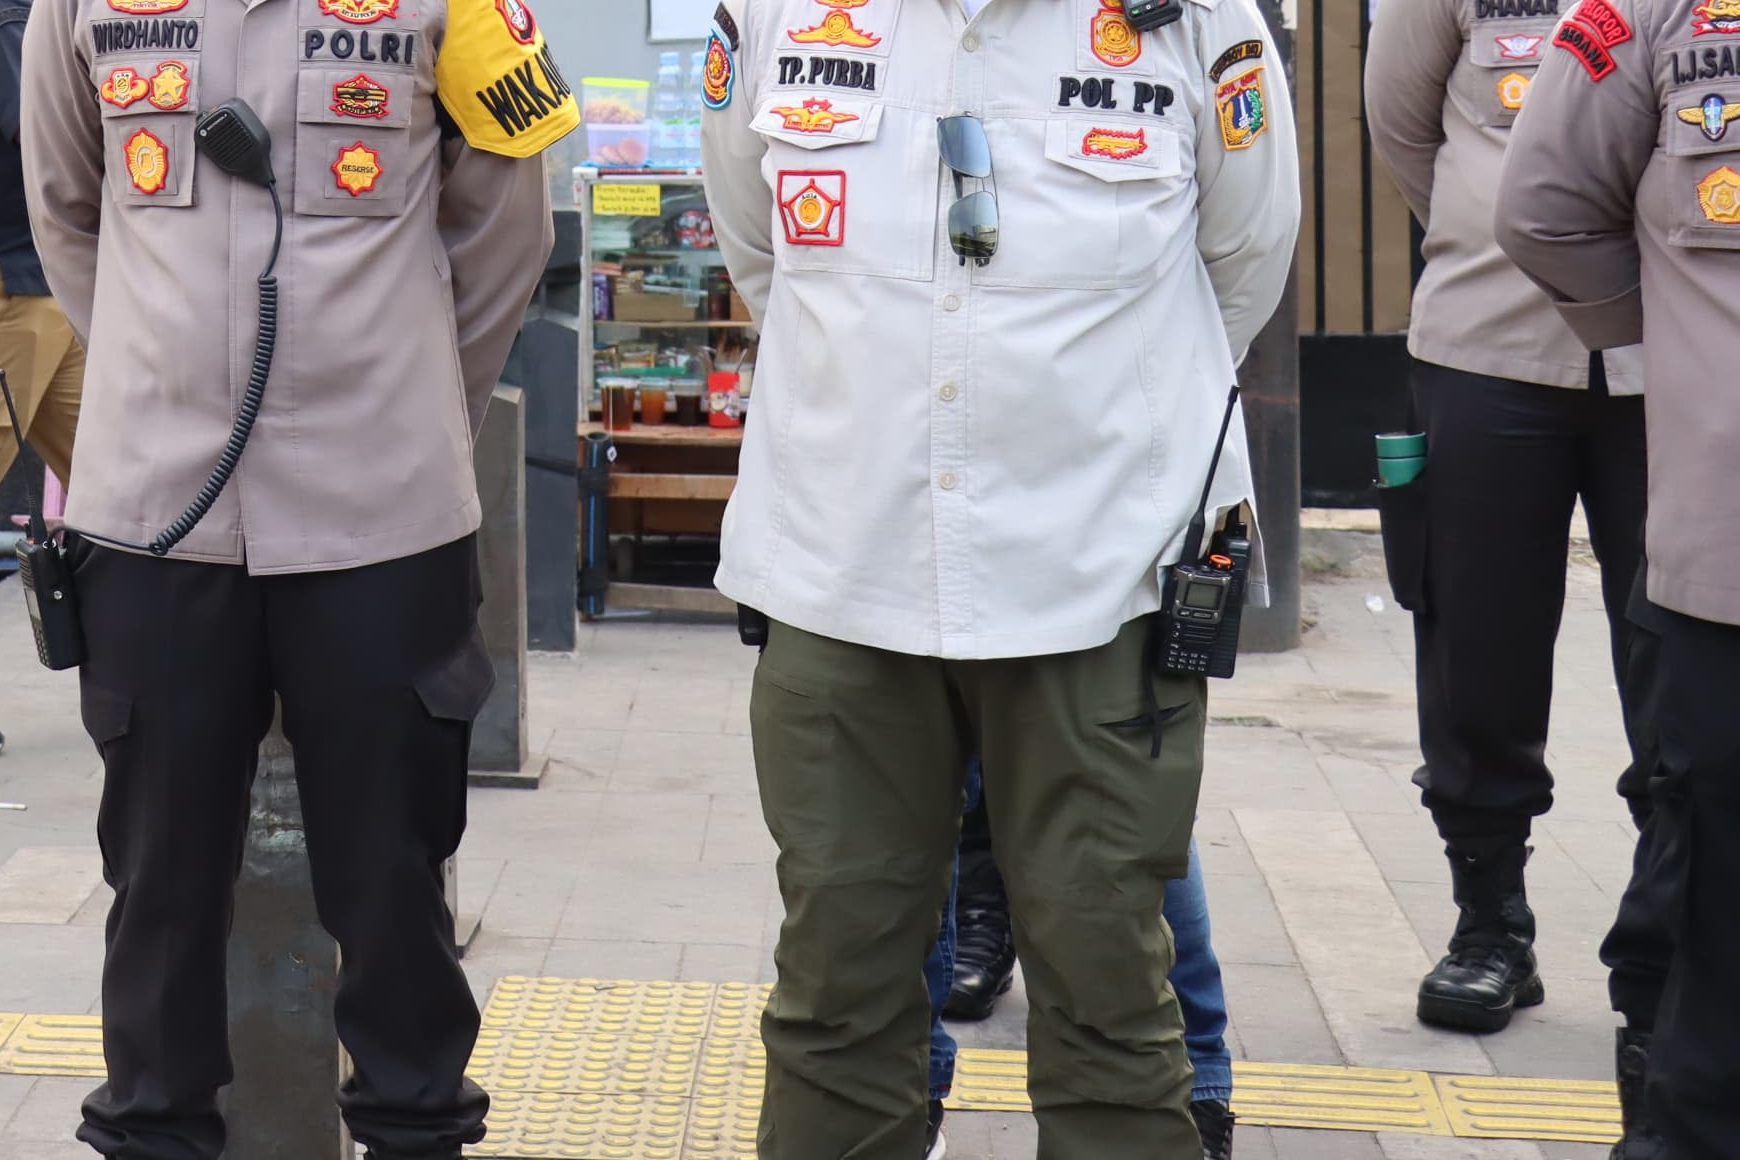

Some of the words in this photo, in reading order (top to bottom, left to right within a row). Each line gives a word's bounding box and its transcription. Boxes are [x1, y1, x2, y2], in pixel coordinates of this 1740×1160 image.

[92, 19, 198, 54] WIRDHANTO
[305, 29, 414, 65] POLRI
[778, 55, 876, 90] TP.PURBA
[1672, 45, 1740, 85] I.J.SA
[1058, 76, 1117, 109] POL
[1133, 81, 1174, 116] PP
[341, 164, 375, 174] RESERSE
